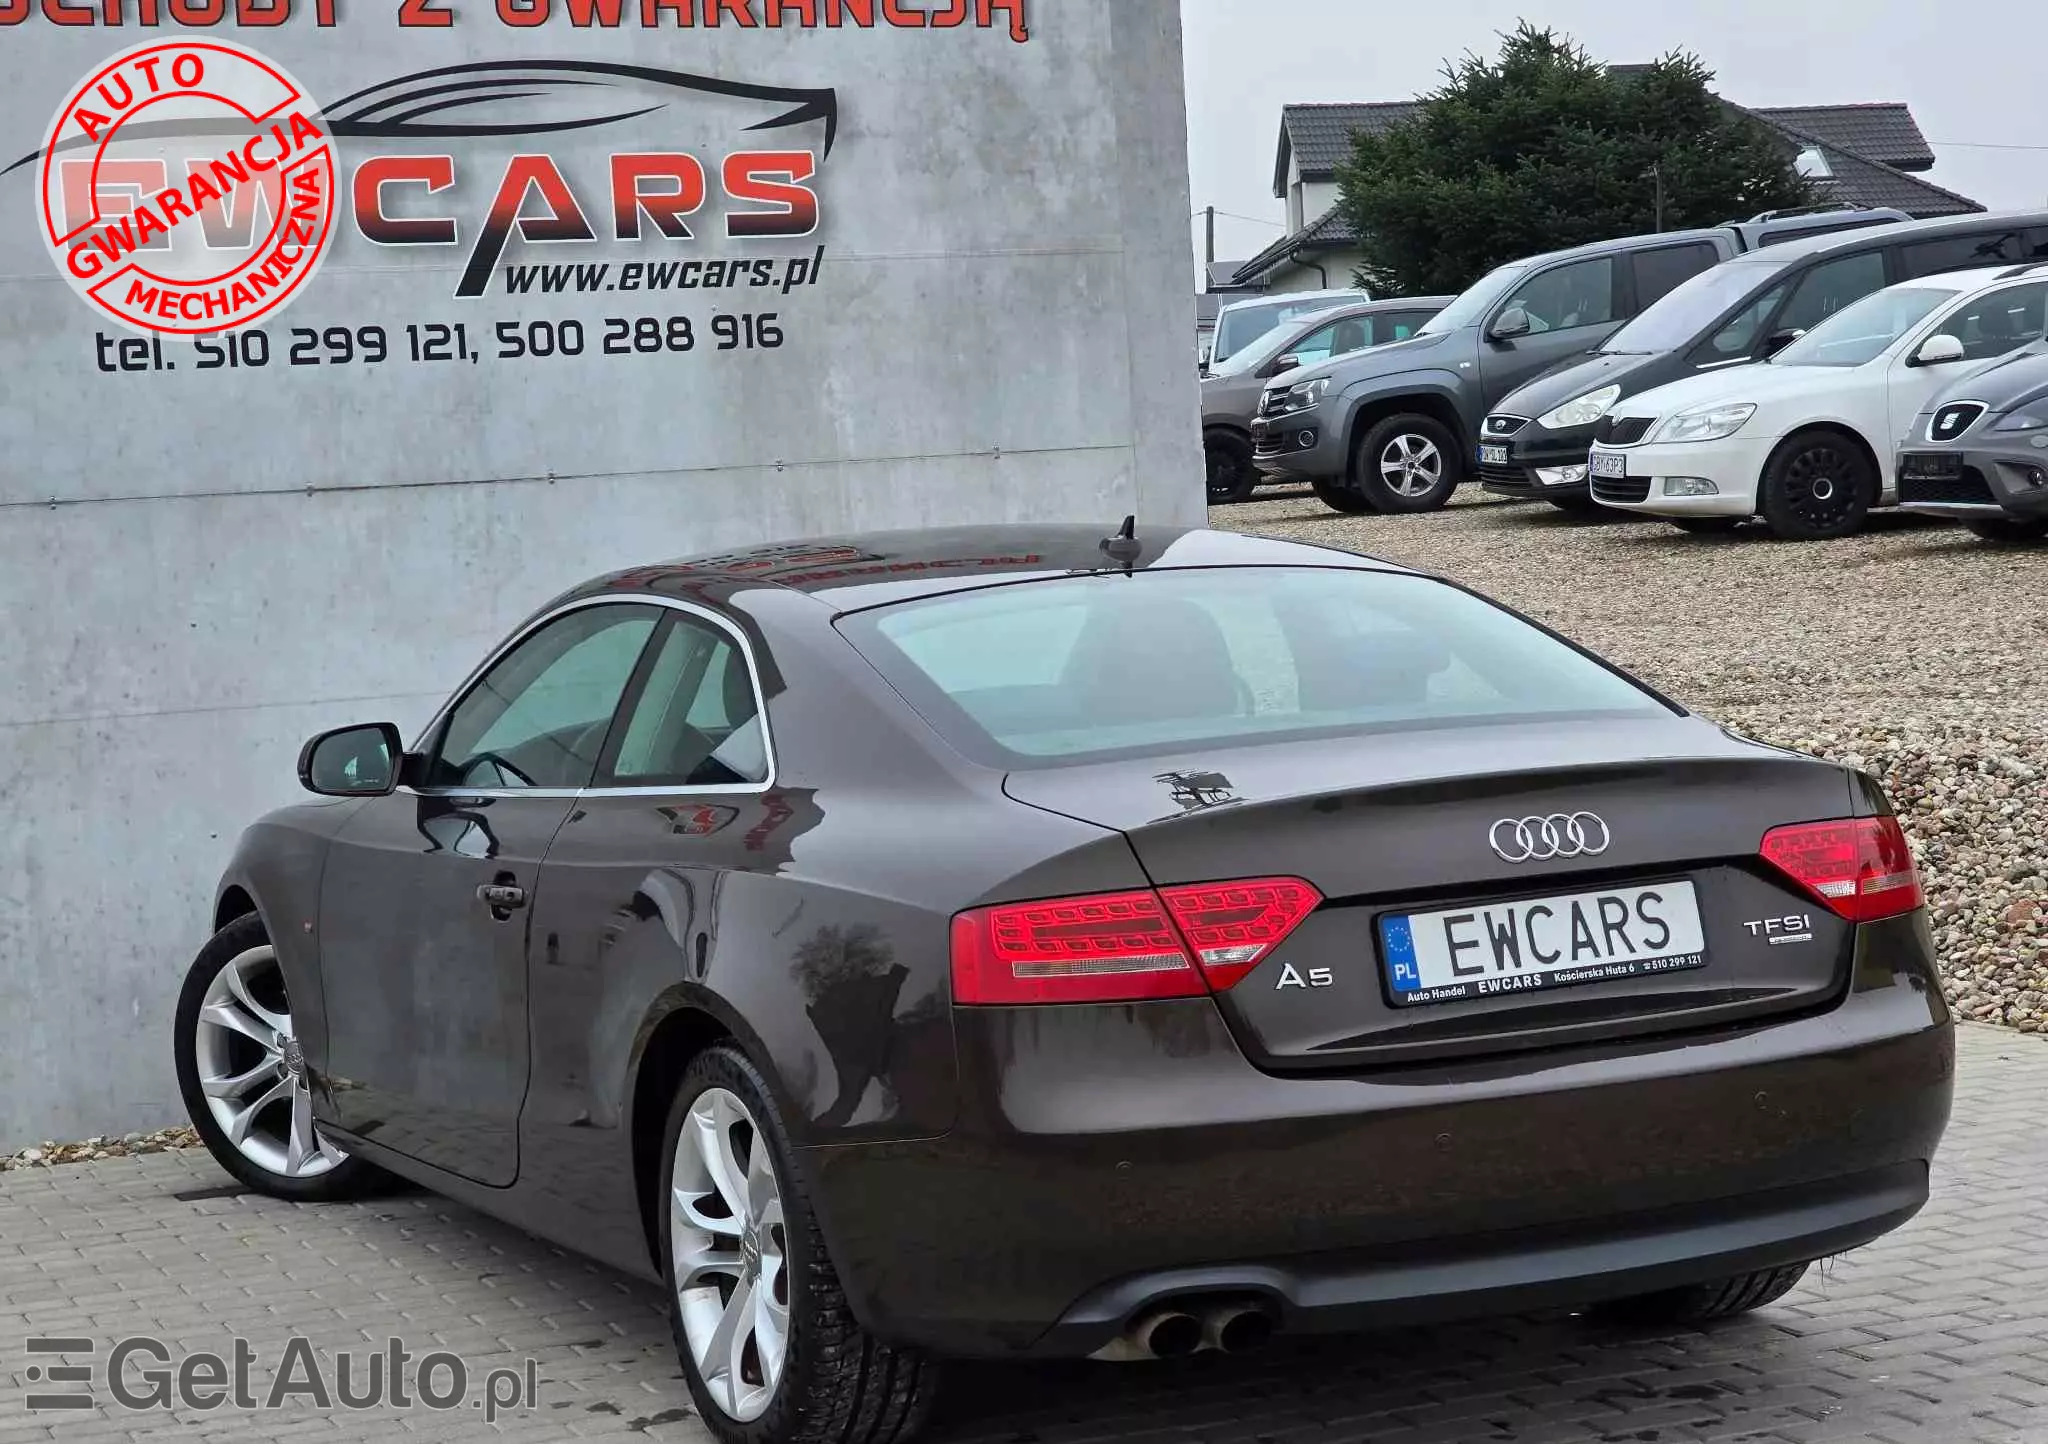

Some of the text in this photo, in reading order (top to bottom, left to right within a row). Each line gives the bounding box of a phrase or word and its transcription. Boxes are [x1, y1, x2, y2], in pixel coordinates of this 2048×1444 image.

[506, 245, 824, 294] www.ewcars.pl
[96, 313, 784, 372] tel. 510 299 121, 500 288 916
[1394, 891, 1670, 981] PL EWCARS
[1743, 914, 1810, 936] TFSI
[1407, 991, 1430, 1003] Auto
[1432, 986, 1466, 999] Handel
[1478, 974, 1542, 993] EWCARS
[1605, 965, 1628, 976] Huta
[1628, 963, 1635, 973] 6
[1651, 959, 1668, 970] 510
[1669, 956, 1686, 966] 299
[1688, 954, 1702, 965] 121
